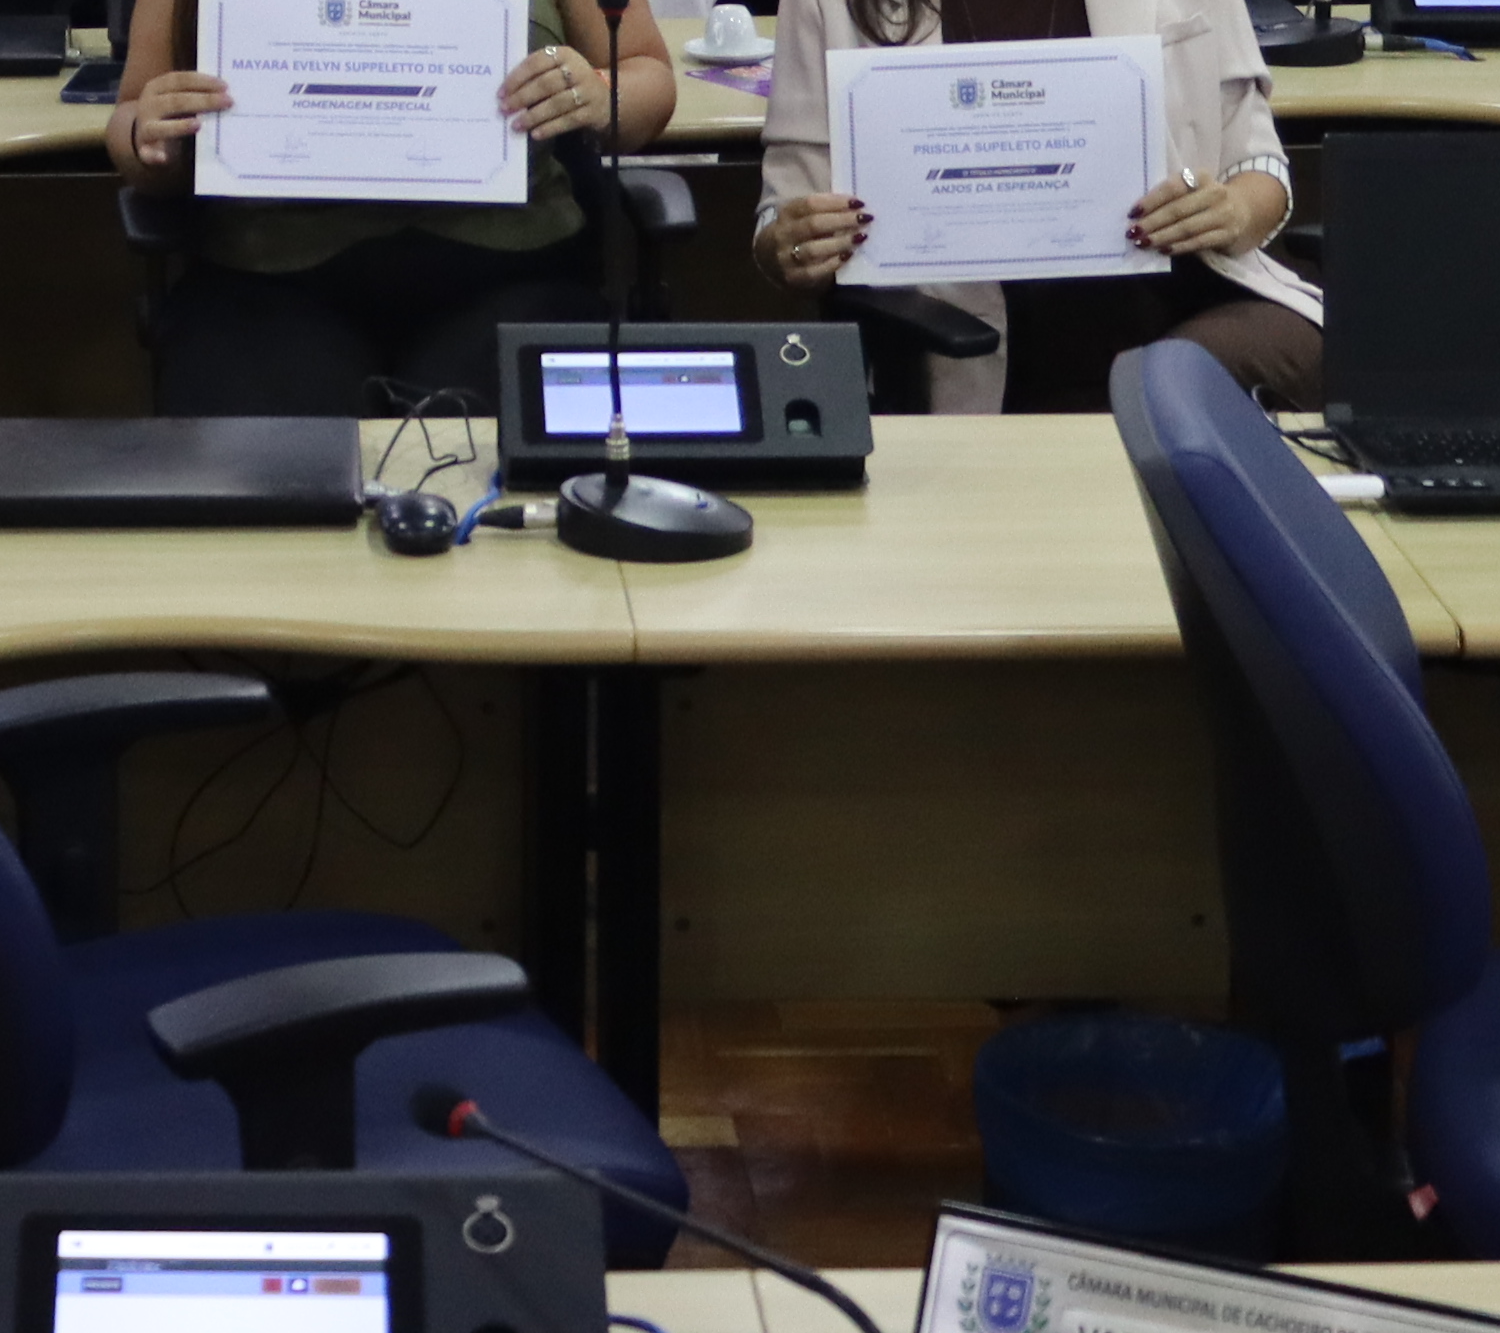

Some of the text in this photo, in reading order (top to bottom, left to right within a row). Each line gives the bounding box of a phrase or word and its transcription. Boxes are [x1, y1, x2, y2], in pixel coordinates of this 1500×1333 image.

[359, 0, 399, 11] Câmara
[358, 10, 411, 22] Municipal
[232, 59, 492, 76] MAYARA EVELYN SUPPELETTO DE SOUZA
[991, 79, 1032, 89] Câmara
[991, 89, 1045, 100] Municipal
[292, 100, 431, 111] HOMENAGEM ESPECIAL
[913, 136, 1086, 155] PRISCILA SUPELETO ABÍLIO
[932, 181, 1069, 194] ANJOS DA ESPERANÇA
[1068, 1272, 1133, 1302] CÂMARA
[1135, 1290, 1217, 1319] MUNICIPAL
